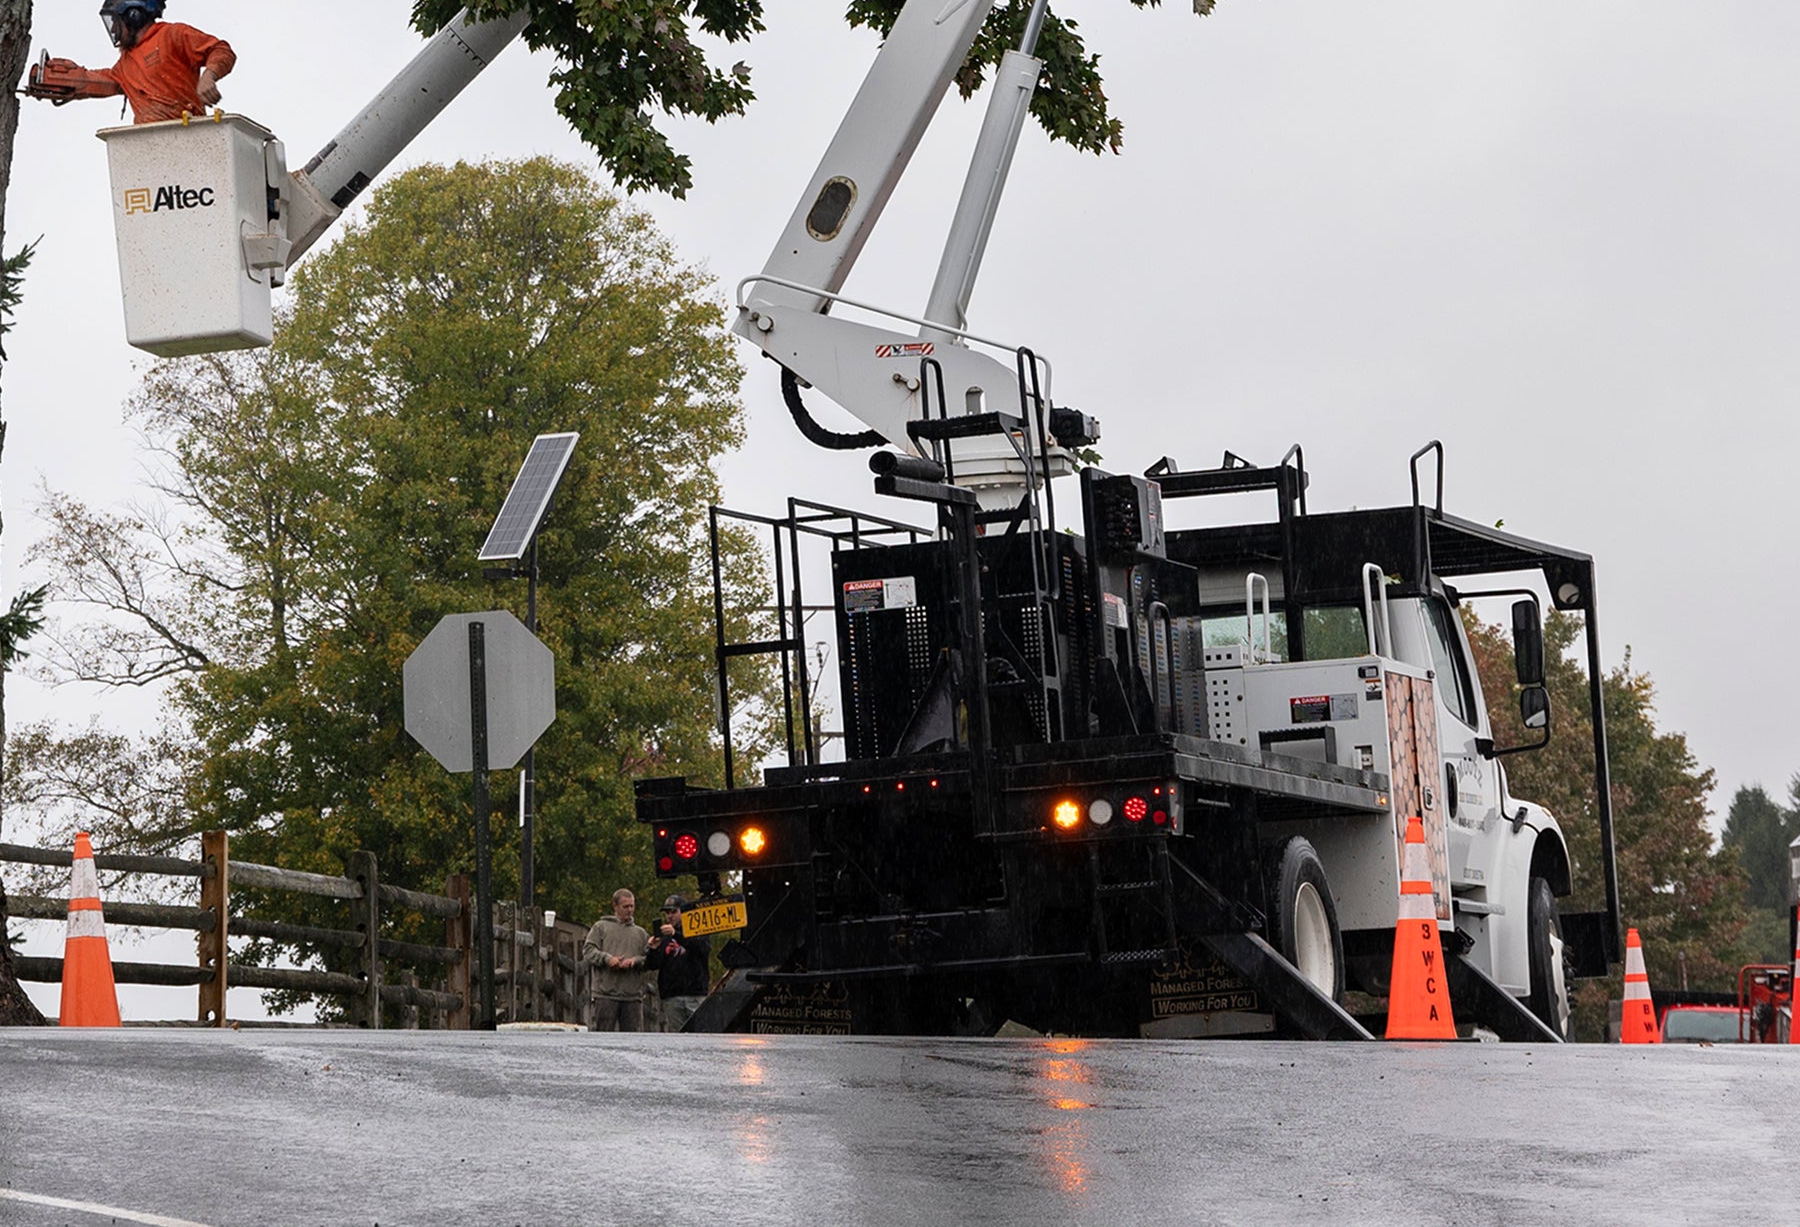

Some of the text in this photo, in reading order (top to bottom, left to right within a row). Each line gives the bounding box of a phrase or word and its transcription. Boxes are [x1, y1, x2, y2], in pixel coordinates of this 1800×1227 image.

[153, 185, 215, 212] Altec
[1151, 977, 1244, 995] MANAGED FORES
[805, 1006, 853, 1020] FORESTS
[1158, 994, 1252, 1014] WORKING FOR YOU
